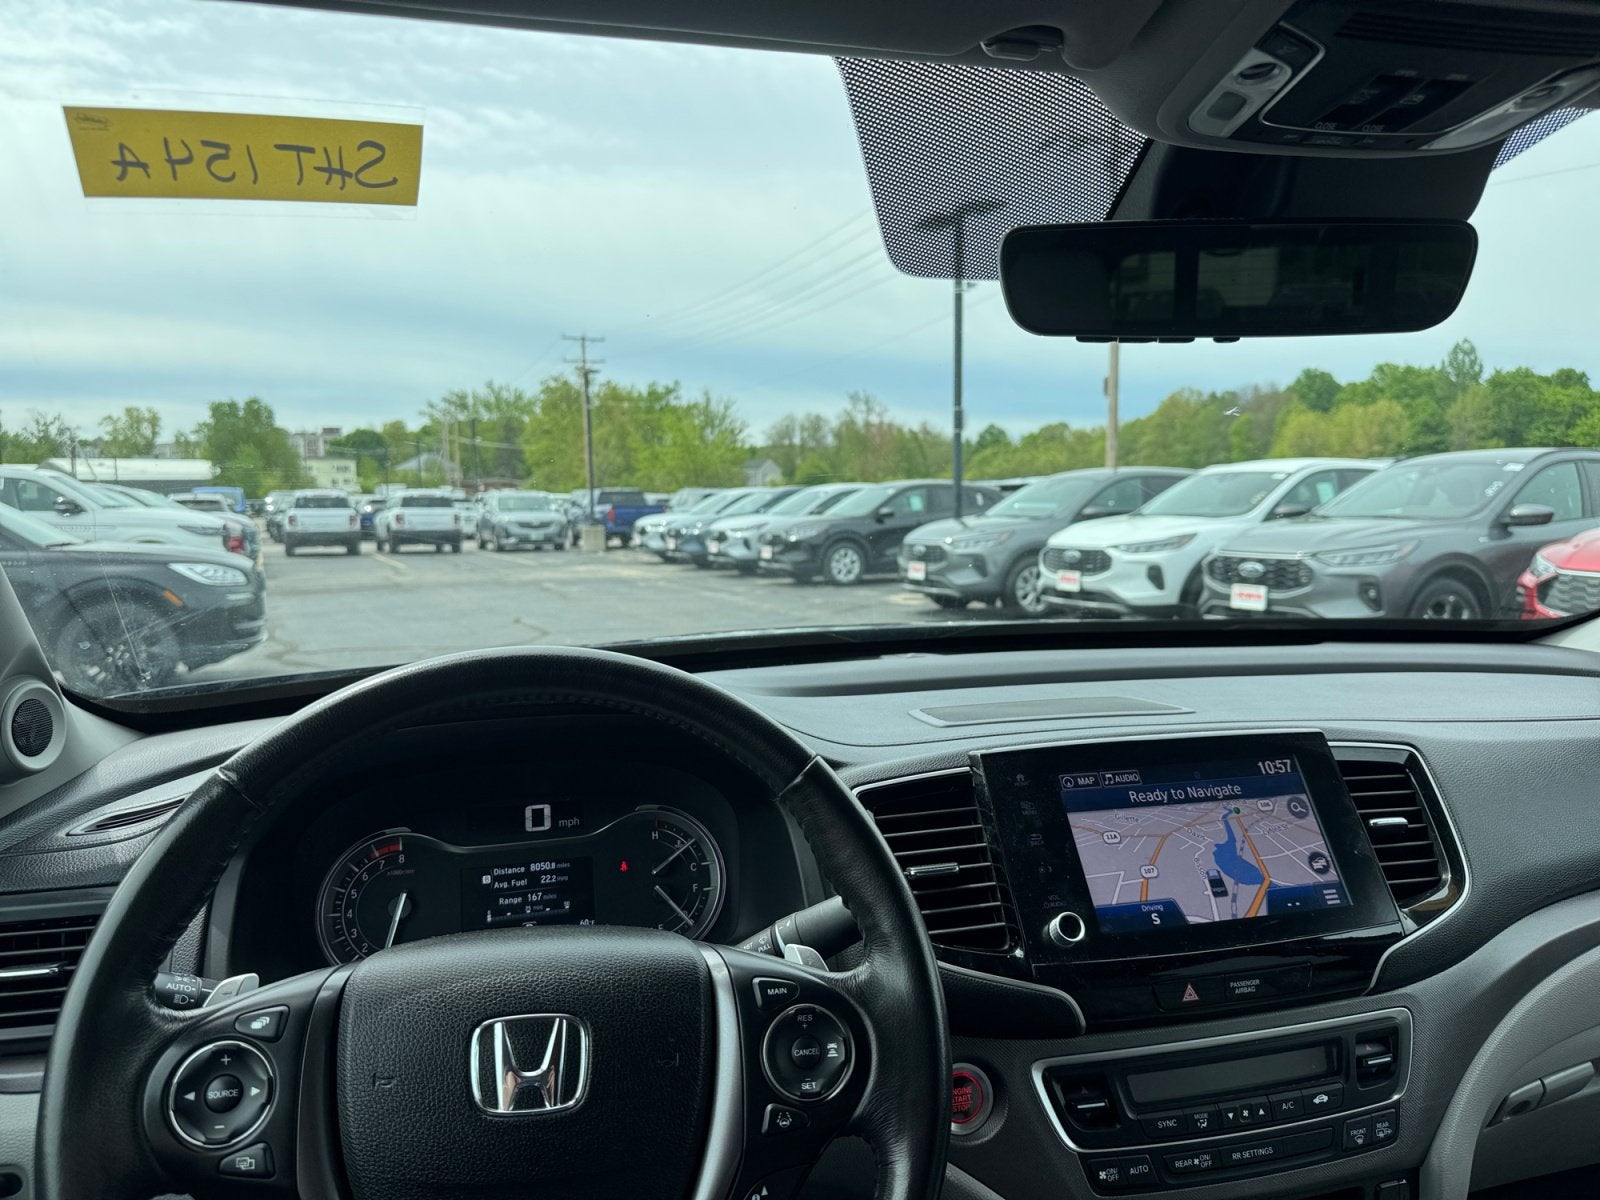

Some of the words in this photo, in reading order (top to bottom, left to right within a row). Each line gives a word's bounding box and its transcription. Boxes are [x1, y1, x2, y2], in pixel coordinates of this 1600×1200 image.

[1257, 759, 1292, 776] 10:57
[1077, 776, 1096, 786] MAP
[1115, 773, 1139, 784] AUDIO
[1129, 788, 1168, 804] Ready
[1170, 788, 1185, 800] to
[1187, 783, 1243, 799] Navigate
[525, 803, 551, 832] 0
[558, 816, 580, 829] mph
[652, 831, 659, 840] H
[398, 853, 405, 864] 8
[379, 860, 385, 870] 7
[690, 862, 697, 872] C
[493, 865, 526, 876] Distance
[1143, 867, 1155, 875] 107
[361, 871, 369, 881] 6
[493, 880, 509, 889] Avg.
[511, 878, 528, 887] Fuel
[692, 884, 698, 892] F
[350, 888, 358, 899] 5
[499, 896, 523, 906] Range
[527, 892, 542, 902] 167
[346, 908, 353, 918] 4
[1151, 912, 1161, 925] S
[351, 928, 358, 938] 3
[361, 943, 368, 953] 2
[166, 983, 192, 992] AUTO
[1229, 978, 1261, 988] PASSENGER
[767, 987, 788, 996] MAIN
[1234, 986, 1257, 995] AIRBAG
[797, 1013, 813, 1023] RES
[794, 1047, 820, 1057] CANCEL
[801, 1081, 817, 1091] SET
[952, 1086, 972, 1096] NGINE
[207, 1087, 239, 1099] SOURCE
[1282, 1101, 1295, 1111] A/C
[1157, 1118, 1177, 1129] SYNC
[1376, 1121, 1390, 1129] REAR
[1350, 1127, 1367, 1137] FRONT
[1232, 1151, 1243, 1161] RR
[1243, 1146, 1274, 1159] SETTINGS
[1174, 1158, 1193, 1169] REAR
[1200, 1160, 1213, 1168] OFF
[1130, 1164, 1149, 1174] AUTO
[1107, 1173, 1119, 1182] OFF
